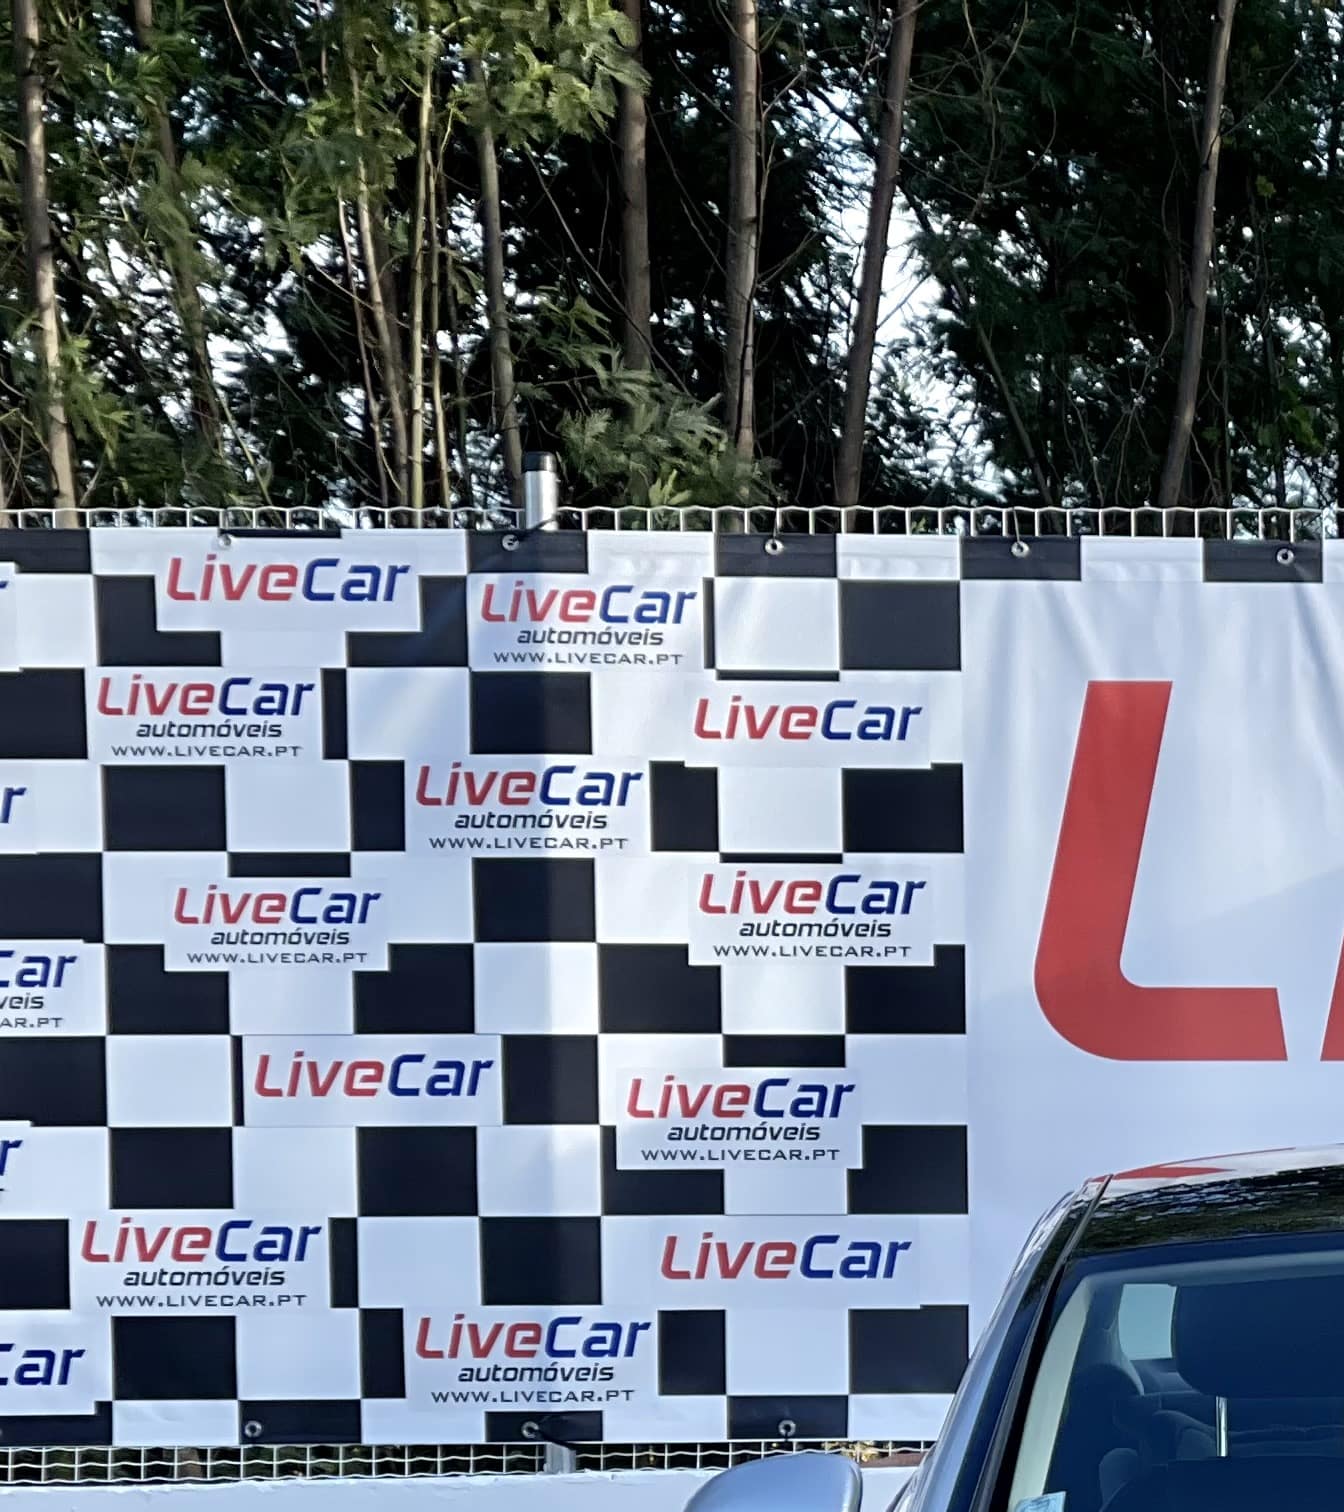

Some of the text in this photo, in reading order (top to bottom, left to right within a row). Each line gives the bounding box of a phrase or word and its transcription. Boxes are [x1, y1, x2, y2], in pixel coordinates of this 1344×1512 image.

[167, 554, 411, 602] LiveCar
[481, 581, 697, 623] LiveCar
[517, 627, 664, 646] automóveis
[493, 651, 683, 665] WWW.LIVECAR.PT
[97, 674, 315, 716] LiveCar
[694, 695, 922, 741] LiveCar
[136, 720, 282, 738] automóveis
[112, 746, 303, 757] WWW.LIVECAR.PT
[416, 762, 643, 805] LiveCar
[454, 810, 607, 829] automóveis
[429, 838, 628, 850] WWW.LIVECAR.PT
[699, 870, 927, 915] LiveCar
[174, 885, 381, 924] LiveCar
[210, 929, 350, 945] automóveis
[739, 919, 892, 937] automóveis
[187, 953, 367, 964] WWW.LIVECAR.PT
[714, 945, 912, 958] WWW.LIVECAR.PT
[255, 1050, 494, 1097] LiveCar
[627, 1076, 854, 1119] LiveCar
[667, 1122, 820, 1141] automóveis
[642, 1149, 840, 1160] WWW.LIVECAR.PT
[81, 1217, 322, 1262] LiveCar
[661, 1232, 912, 1280] LiveCar
[123, 1267, 285, 1286] automóveis
[97, 1295, 307, 1307] WWW.LIVECAR.PT
[415, 1314, 650, 1358] LiveCar
[458, 1362, 614, 1382] automóveis
[431, 1390, 635, 1402] WWW.LIVECAR.PT
